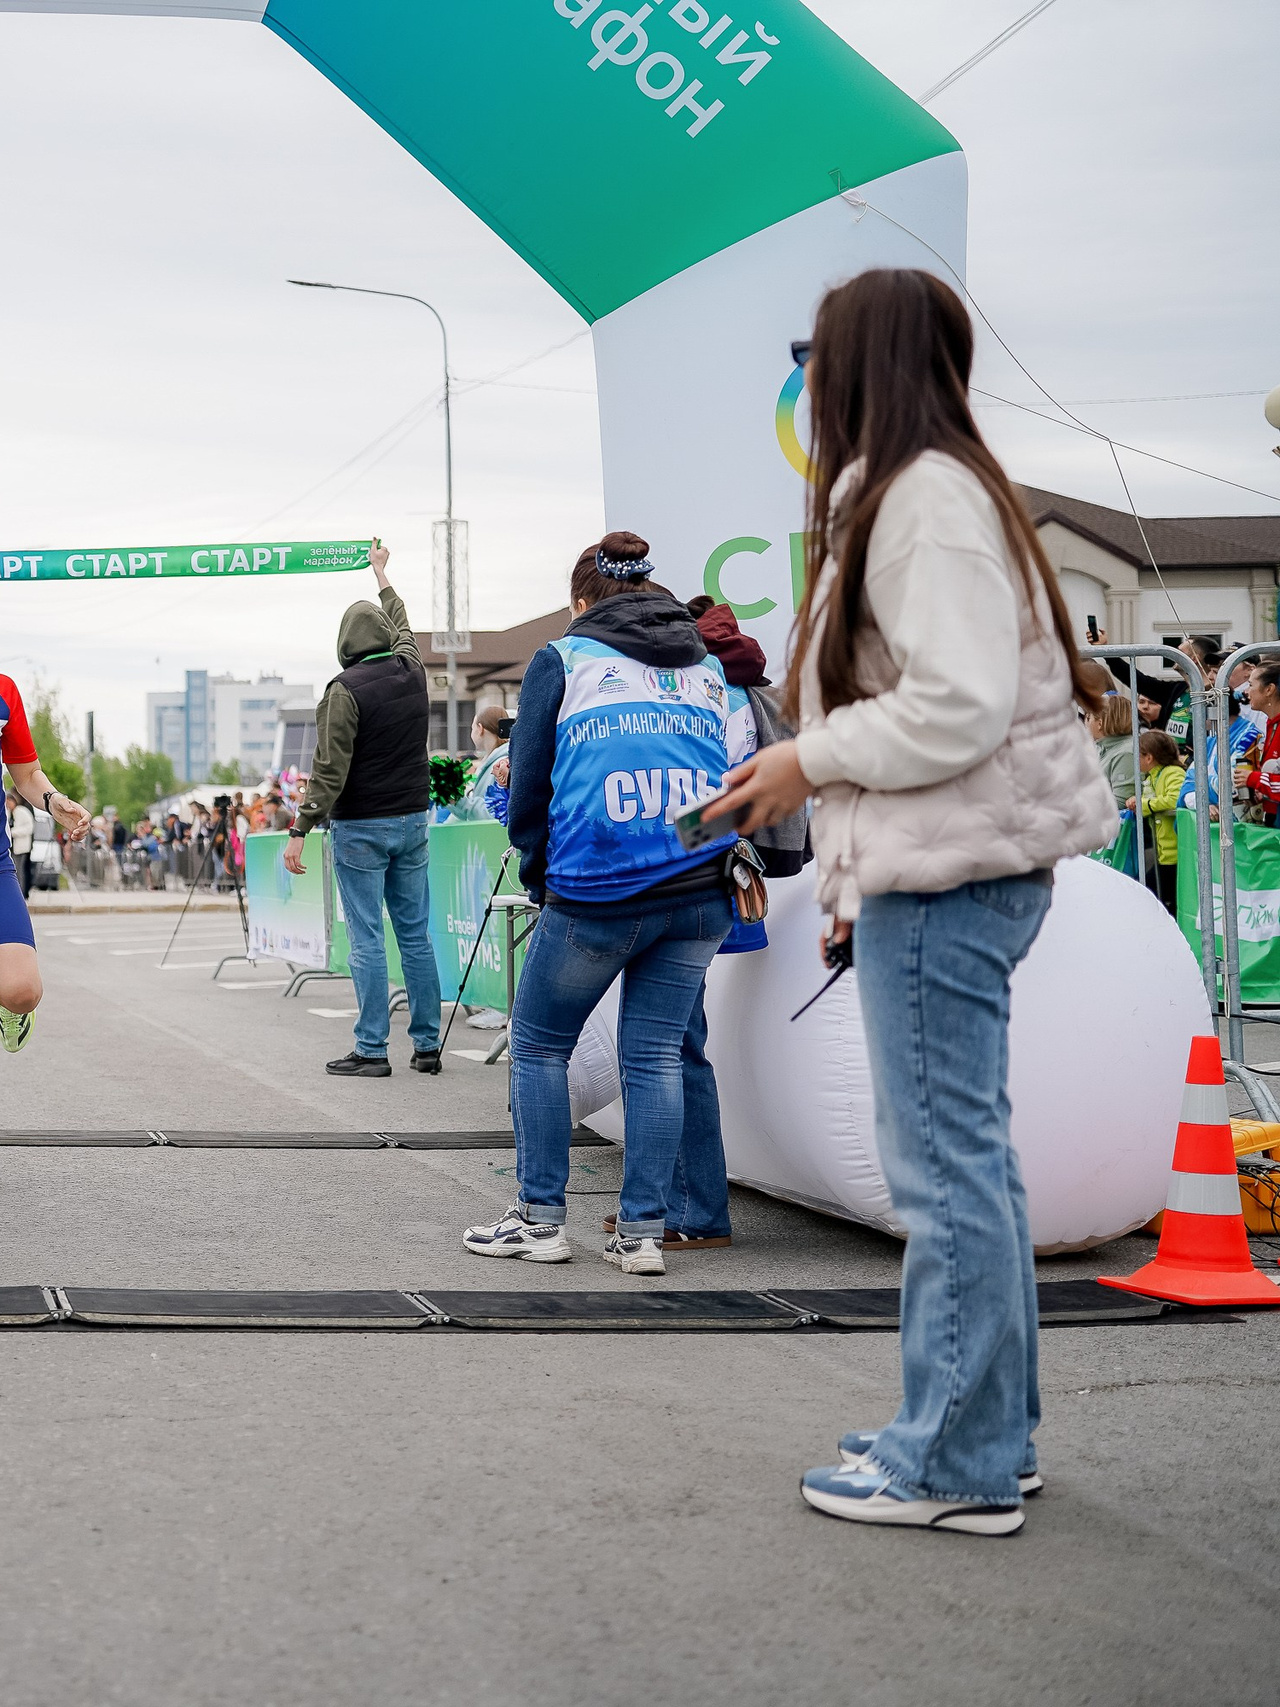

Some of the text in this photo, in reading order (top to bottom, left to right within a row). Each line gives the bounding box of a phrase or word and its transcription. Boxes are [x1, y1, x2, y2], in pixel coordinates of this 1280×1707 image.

[310, 545, 358, 556] зелёный
[65, 552, 168, 577] СТАРТ
[190, 546, 292, 574] СТАРТ
[303, 555, 353, 567] марафон
[603, 767, 731, 826] СУДЬ
[446, 914, 454, 933] В
